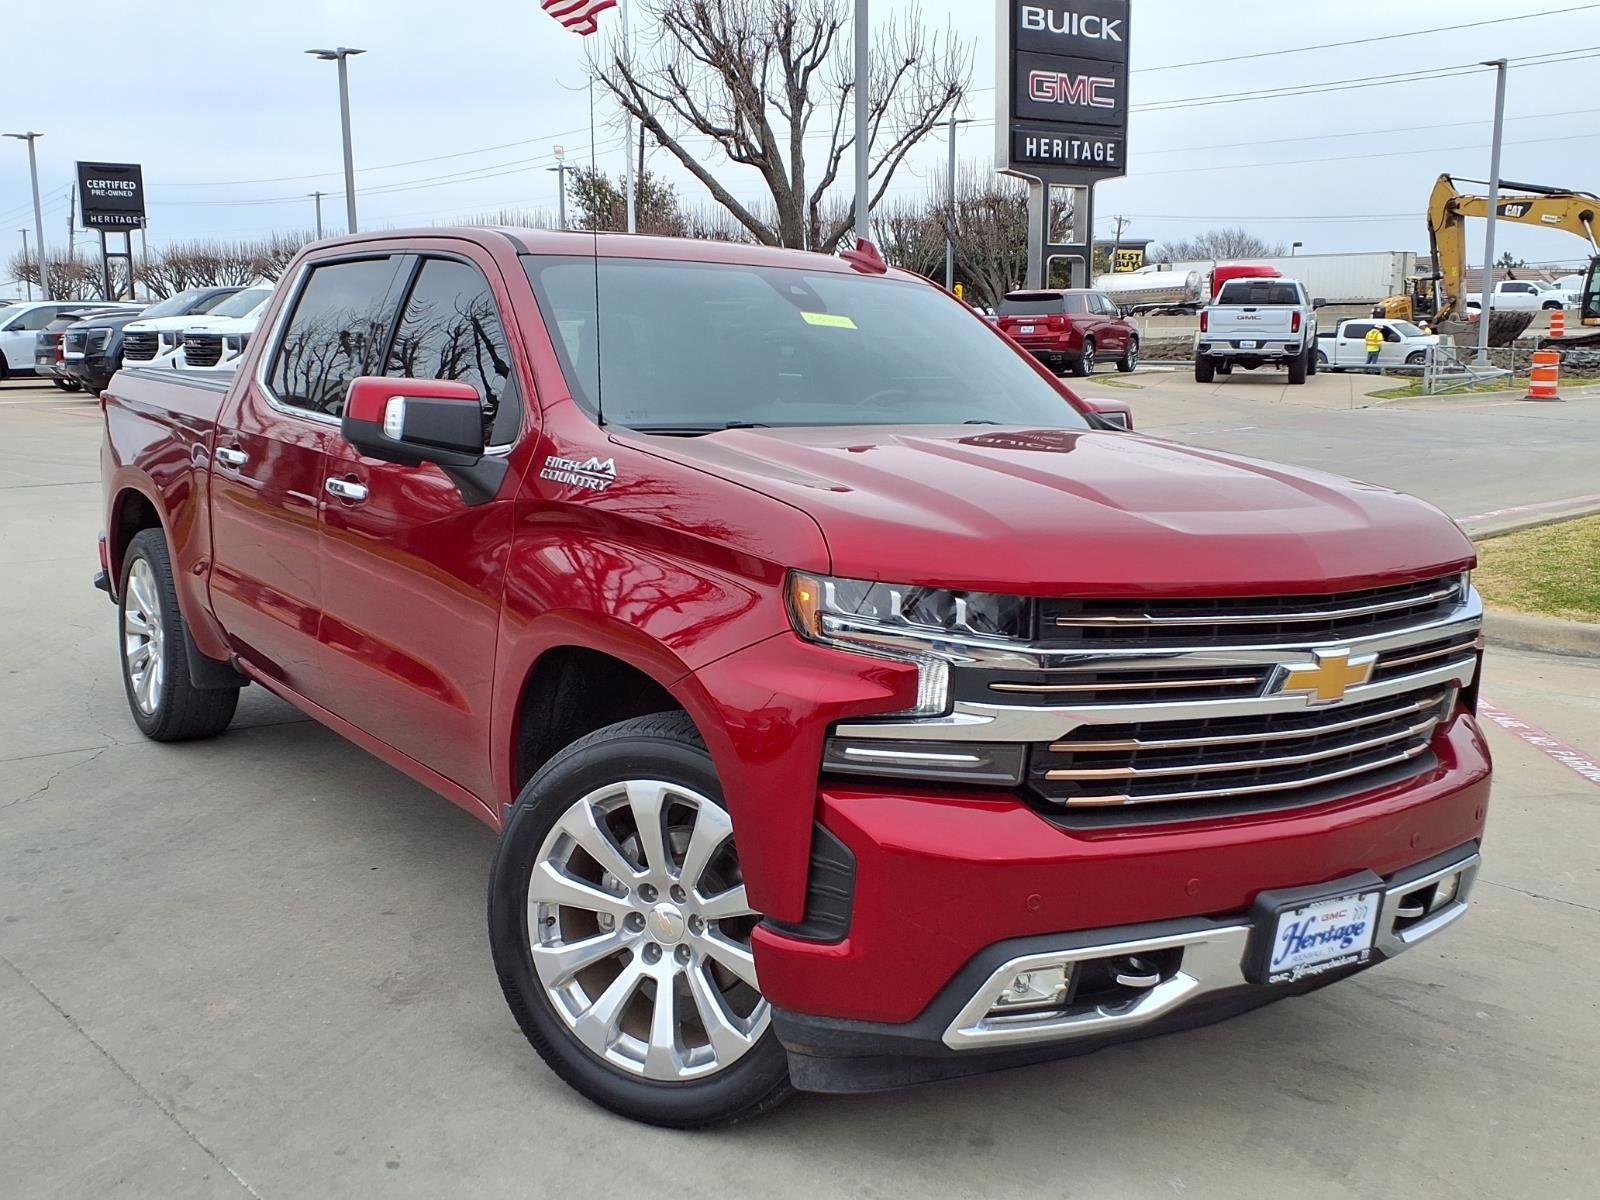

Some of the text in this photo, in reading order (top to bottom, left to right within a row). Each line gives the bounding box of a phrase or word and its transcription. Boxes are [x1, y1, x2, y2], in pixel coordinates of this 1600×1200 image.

[1021, 5, 1123, 42] BUICK
[1028, 69, 1115, 109] GMC
[1025, 137, 1115, 162] HERITAGE
[86, 180, 136, 189] CERTIFIED
[90, 215, 139, 224] HERITAGE
[1504, 205, 1524, 217] CAT
[545, 455, 580, 471] HIGH
[540, 468, 613, 491] COUNTRY
[1321, 909, 1347, 922] GMC
[1272, 915, 1366, 966] Heritage
